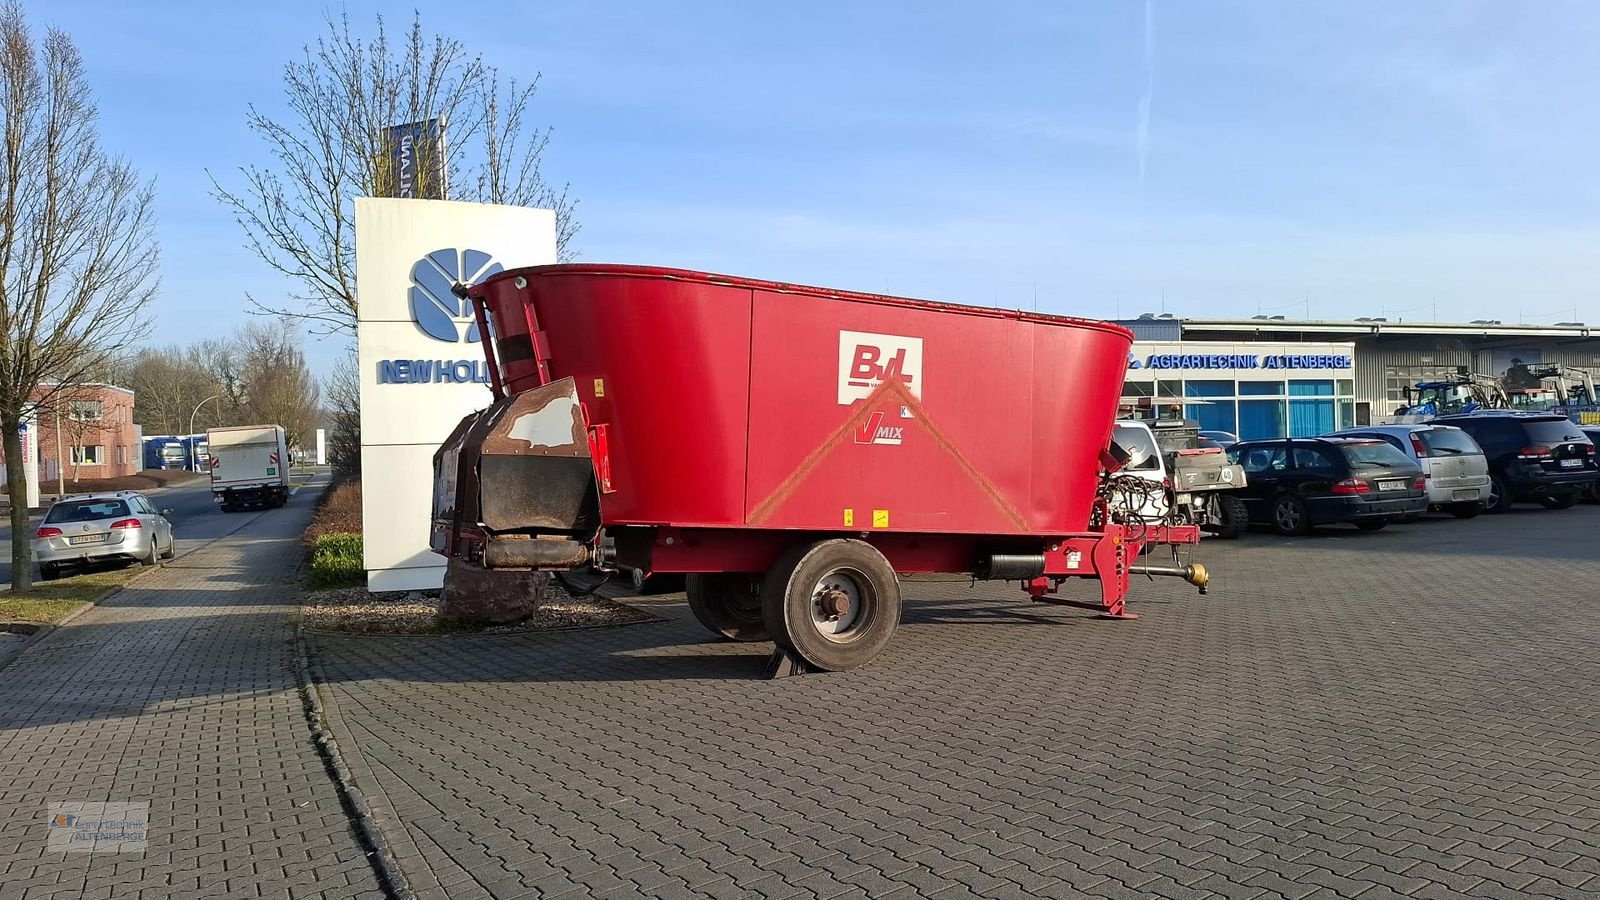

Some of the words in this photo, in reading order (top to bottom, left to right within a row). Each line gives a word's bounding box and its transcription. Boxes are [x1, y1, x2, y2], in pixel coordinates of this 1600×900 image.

[1147, 355, 1259, 369] AGRARTECHNIK
[1263, 355, 1352, 369] ALTENBERGE
[376, 360, 433, 384] NEW
